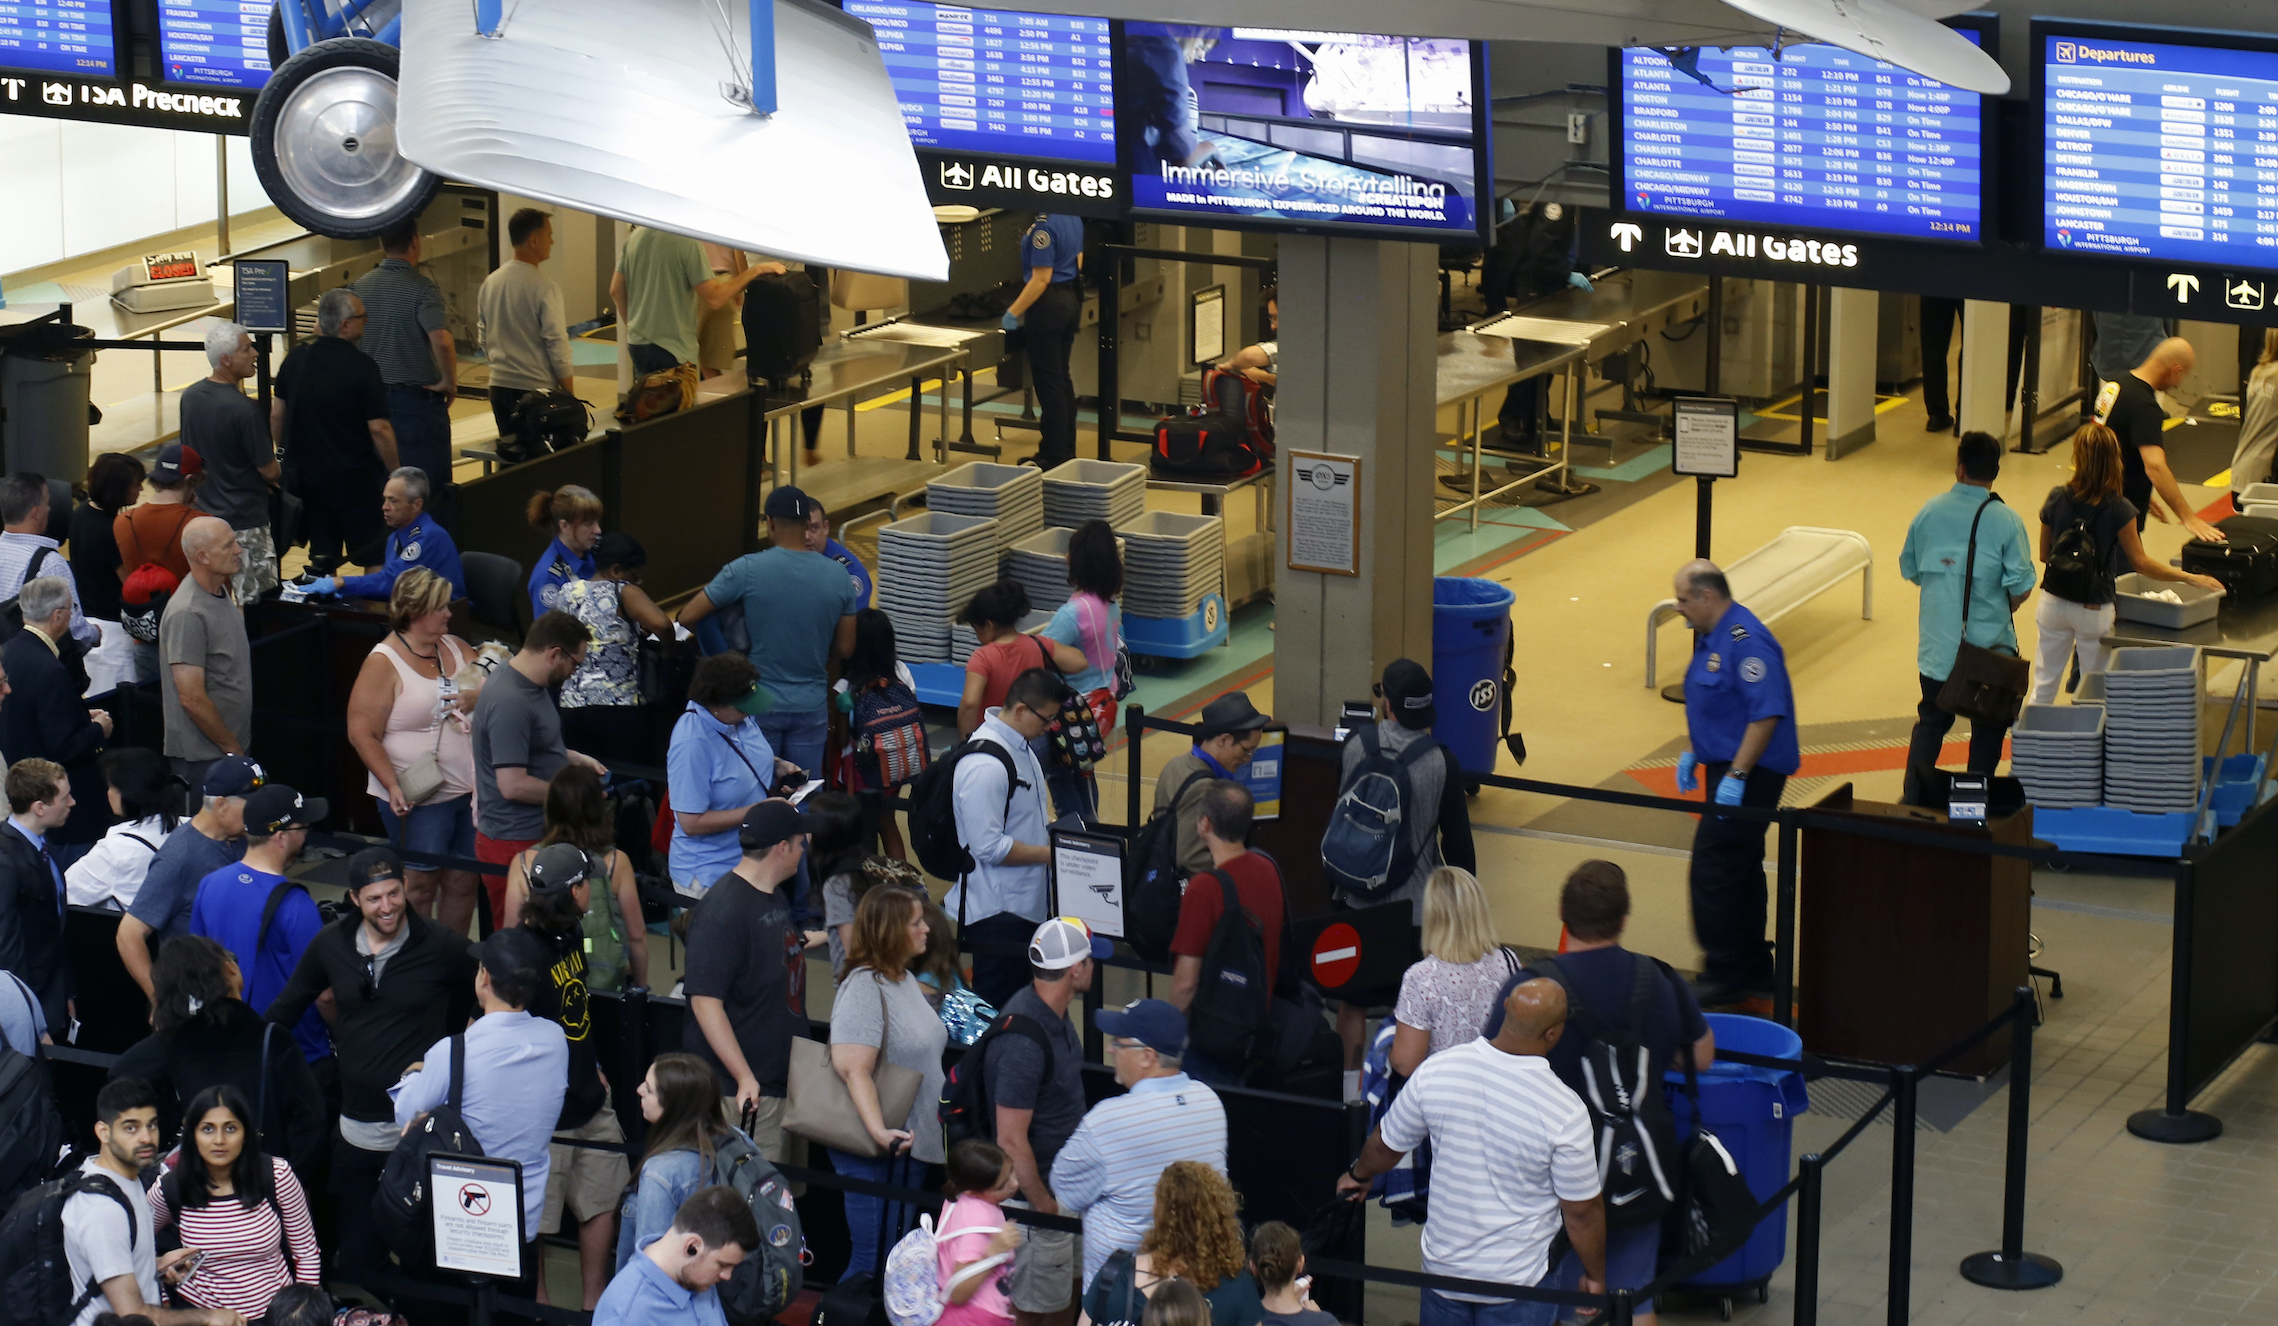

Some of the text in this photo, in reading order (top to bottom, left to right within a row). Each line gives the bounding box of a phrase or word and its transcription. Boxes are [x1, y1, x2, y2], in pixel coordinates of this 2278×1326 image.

[166, 9, 199, 18] FRANKLIN
[851, 4, 908, 16] ORLANDO/MCO
[70, 23, 86, 31] TIME
[167, 21, 212, 30] HAGERSTOWN
[1035, 18, 1049, 27] AM
[70, 34, 87, 42] TIME
[1036, 30, 1049, 39] PM
[72, 45, 88, 53] TIME
[168, 43, 210, 52] JOHNSTOWN
[169, 54, 207, 64] LANCASTER
[1734, 51, 1759, 60] AIRLINE
[1783, 54, 1806, 63] FLIGHT
[2078, 45, 2156, 64] Departures
[76, 59, 107, 69] 12:14 PM
[1833, 58, 1849, 66] TIME
[194, 67, 234, 77] PITTSBURGH
[1633, 68, 1672, 79] ATLANTA
[1845, 73, 1860, 82] PM
[186, 75, 243, 84] INTERNATIONAL AIRPORT
[1042, 79, 1055, 88] PM
[1907, 77, 1920, 87] On
[1633, 81, 1672, 92] ATLANTA
[1843, 85, 1857, 95] PM
[2057, 75, 2240, 98] DESTINATION AIRLINE FLIGHT
[1042, 91, 1055, 100] PM
[1633, 94, 1668, 105] BOSTON
[1907, 90, 1927, 100] Now
[2056, 89, 2132, 104] CHICAGO/O'HARE
[1038, 103, 1051, 112] PM
[1843, 98, 1857, 107] PM
[1907, 103, 1927, 113] Now
[1633, 106, 1679, 118] BRADFORD
[1843, 111, 1857, 120] PM
[2056, 102, 2132, 117] CHICAGO/O'HARE
[1634, 119, 1688, 131] CHARLESTON
[1907, 115, 1942, 127] On Time
[2056, 115, 2112, 129] DALLAS/DFW
[1634, 131, 1682, 144] CHARLOTTE
[2056, 128, 2091, 140] DENVER
[1634, 144, 1682, 156] CHARLOTTE
[2056, 141, 2093, 153] DETROIT
[1634, 157, 1682, 169] CHARLOTTE
[1907, 154, 1927, 164] Now
[2056, 154, 2093, 166] DETROIT
[1160, 159, 1290, 192] Immersive
[1634, 169, 1710, 183] CHICAGO/MIDWAY
[1907, 167, 1942, 178] On Time
[2056, 167, 2099, 179] FRANKLIN
[980, 164, 1114, 198] All Gates
[2056, 180, 2117, 194] HAGERSTOWN
[1634, 182, 1710, 196] CHICAGO/MIDWAY
[1845, 188, 1860, 197] PM
[1357, 191, 1444, 210] #CREATEPGH
[1664, 196, 1715, 208] PITTSBURGH
[1907, 192, 1942, 204] On Time
[2056, 193, 2119, 207] HOUSTON/IAH
[1166, 191, 1195, 204] MADE
[1273, 199, 1340, 215] EXPERIENCED
[1341, 204, 1385, 217] AROUND
[1386, 206, 1406, 219] THE
[1407, 208, 1447, 222] WORLD.
[1653, 204, 1726, 217] INTERNATIONAL AIRPORT
[1907, 205, 1942, 217] On Time
[2056, 205, 2112, 219] JOHNSTOWN
[1930, 221, 1971, 233] 12:14 PM
[2056, 218, 2105, 231] LANCASTER
[2086, 232, 2140, 246] PITTSBURGH
[1709, 231, 1858, 267] All Gates
[2074, 241, 2151, 255] INTERNATIONAL AIRPORT
[150, 262, 196, 280] CLOSED
[453, 1165, 475, 1174] Advisory
